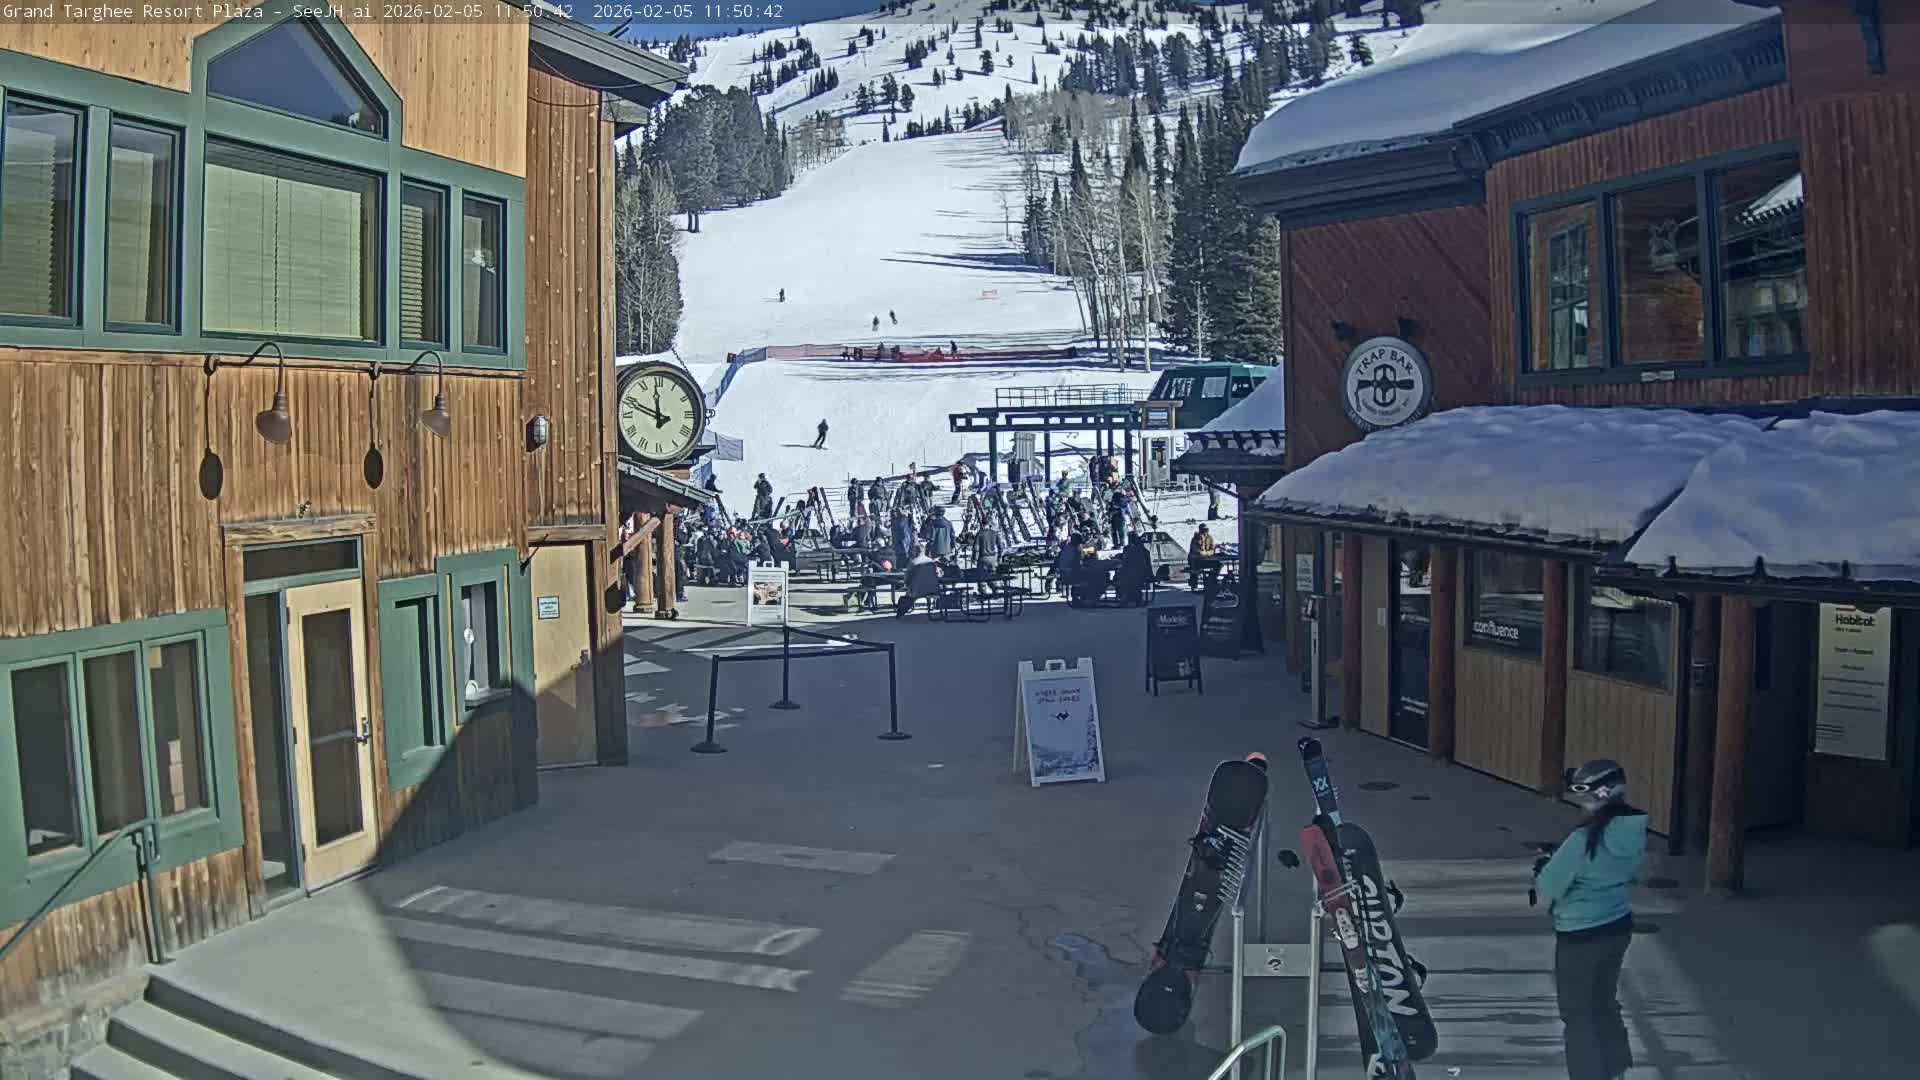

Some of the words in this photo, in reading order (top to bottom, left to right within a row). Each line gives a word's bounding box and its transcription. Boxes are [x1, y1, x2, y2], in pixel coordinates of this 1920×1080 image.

[1356, 348, 1386, 376] TRAP
[1389, 350, 1414, 374] BAR
[1473, 620, 1519, 639] confluence
[1835, 613, 1875, 627] Habitat
